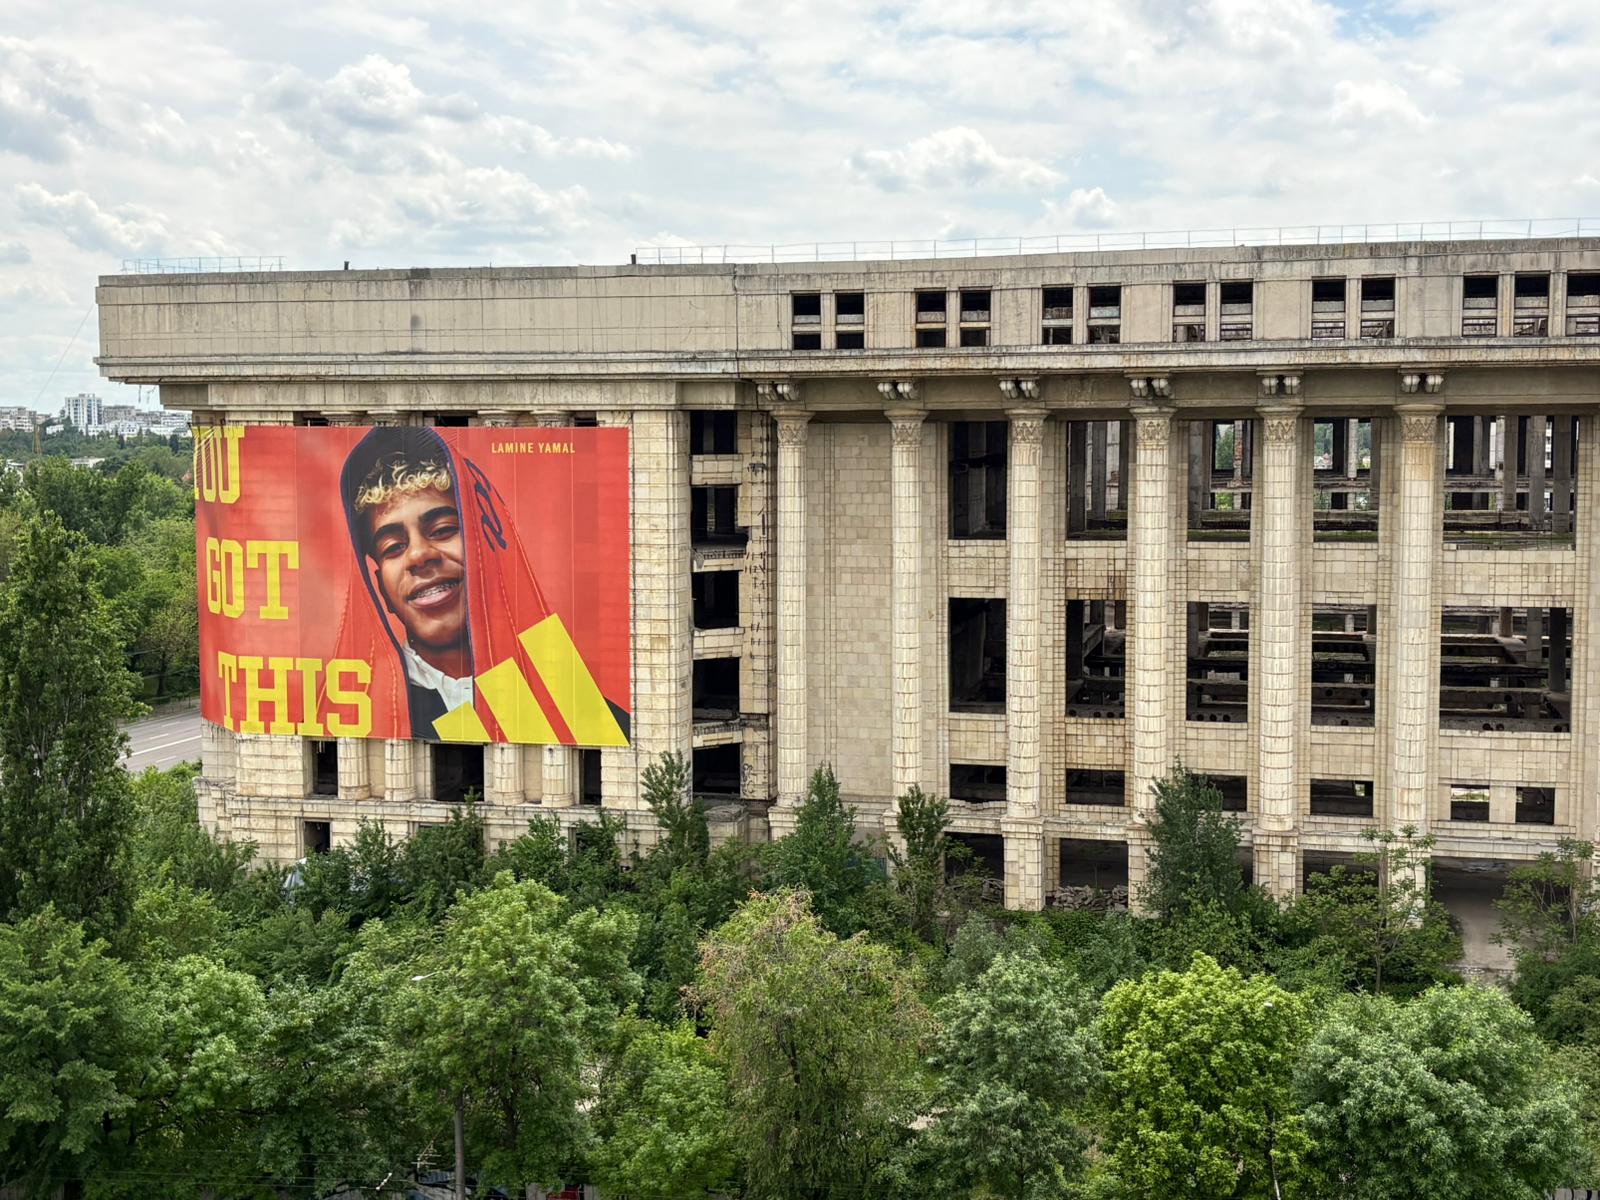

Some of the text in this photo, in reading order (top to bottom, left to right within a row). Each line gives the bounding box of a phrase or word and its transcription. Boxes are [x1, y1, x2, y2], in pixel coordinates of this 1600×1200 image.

[491, 442, 575, 454] LAMINE YAMAL
[206, 536, 299, 619] GOT
[217, 651, 372, 737] THIS
